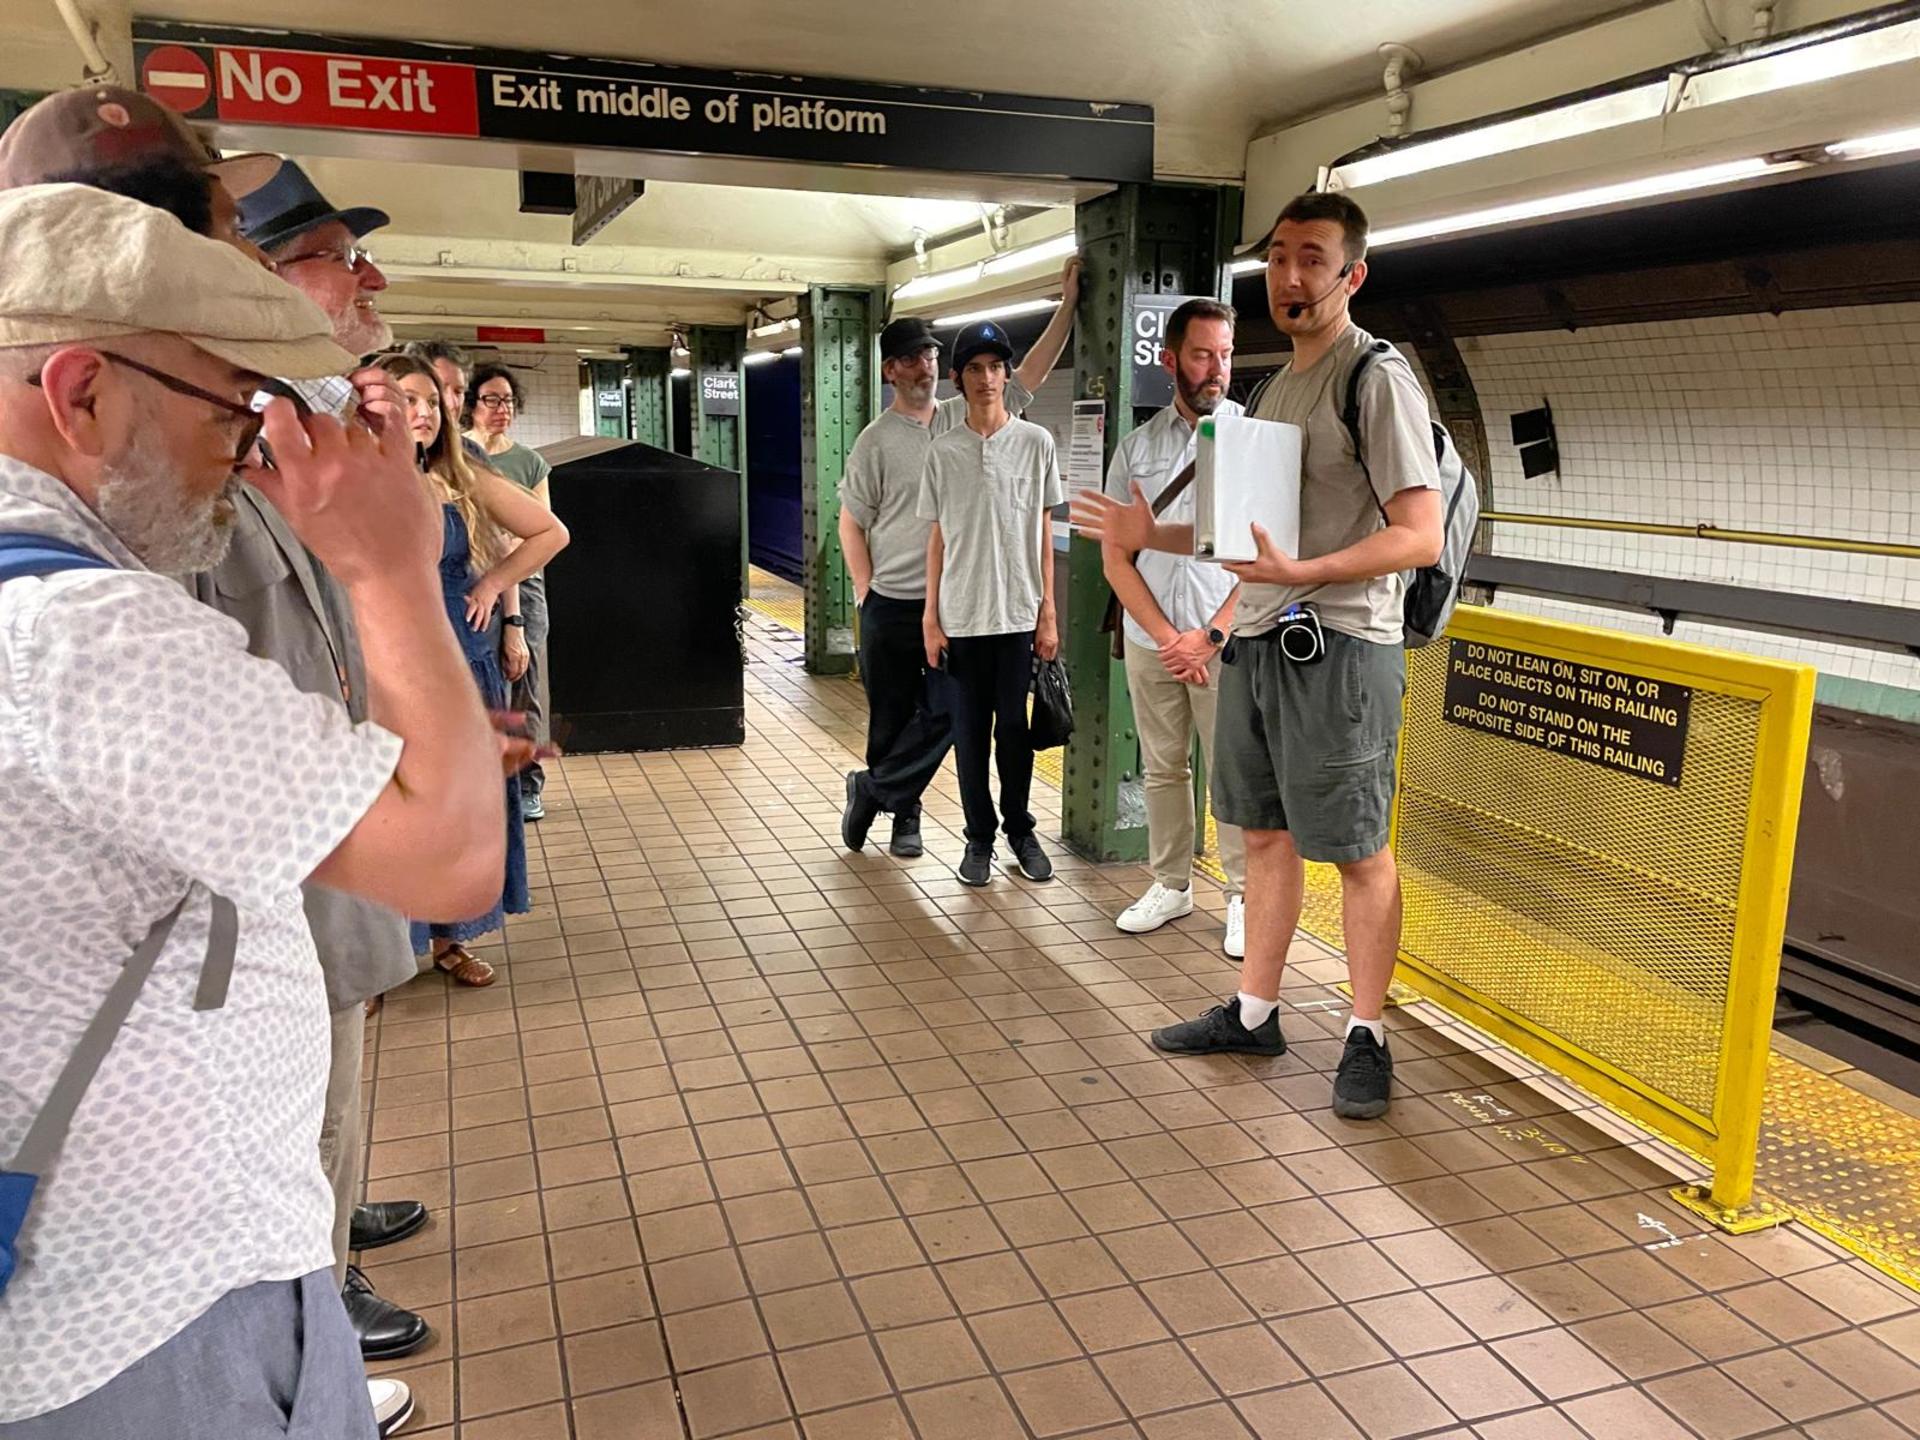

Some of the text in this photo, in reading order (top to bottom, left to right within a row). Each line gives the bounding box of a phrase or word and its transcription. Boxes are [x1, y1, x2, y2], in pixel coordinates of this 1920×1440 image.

[219, 52, 436, 115] No Exit
[491, 73, 887, 136] Exit middle of platform
[703, 388, 739, 400] Street
[704, 376, 737, 389] Clark
[1454, 660, 1678, 727] PLACE OBJECTS ON THIS RAILING
[1467, 644, 1659, 699] DO NOT LEAN ON, SIT ON, OR
[1453, 704, 1665, 777] OPPOSITE SIDE OF THIS RAILING
[1479, 692, 1632, 746] DO NOT STAND ON THE
